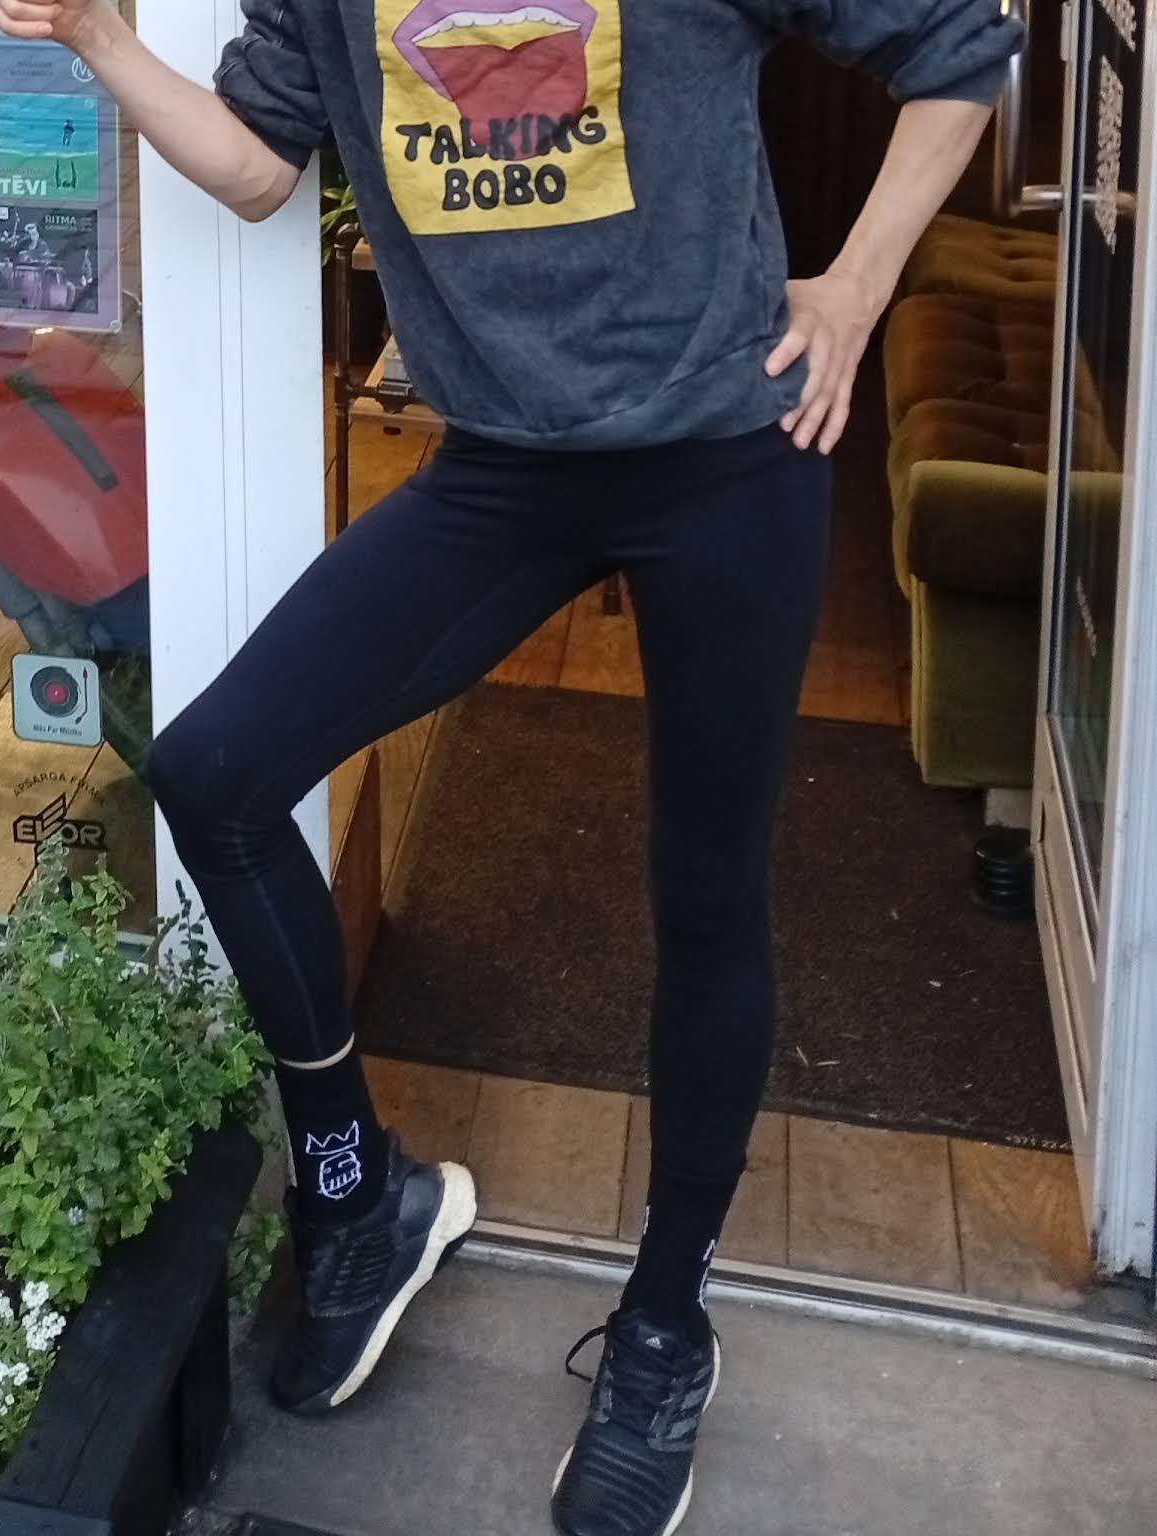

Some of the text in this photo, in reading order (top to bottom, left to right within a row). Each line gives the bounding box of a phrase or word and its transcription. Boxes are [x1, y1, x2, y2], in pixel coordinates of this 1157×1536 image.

[395, 105, 607, 165] TALKING
[442, 164, 567, 211] BOBO
[45, 214, 77, 224] RITMA
